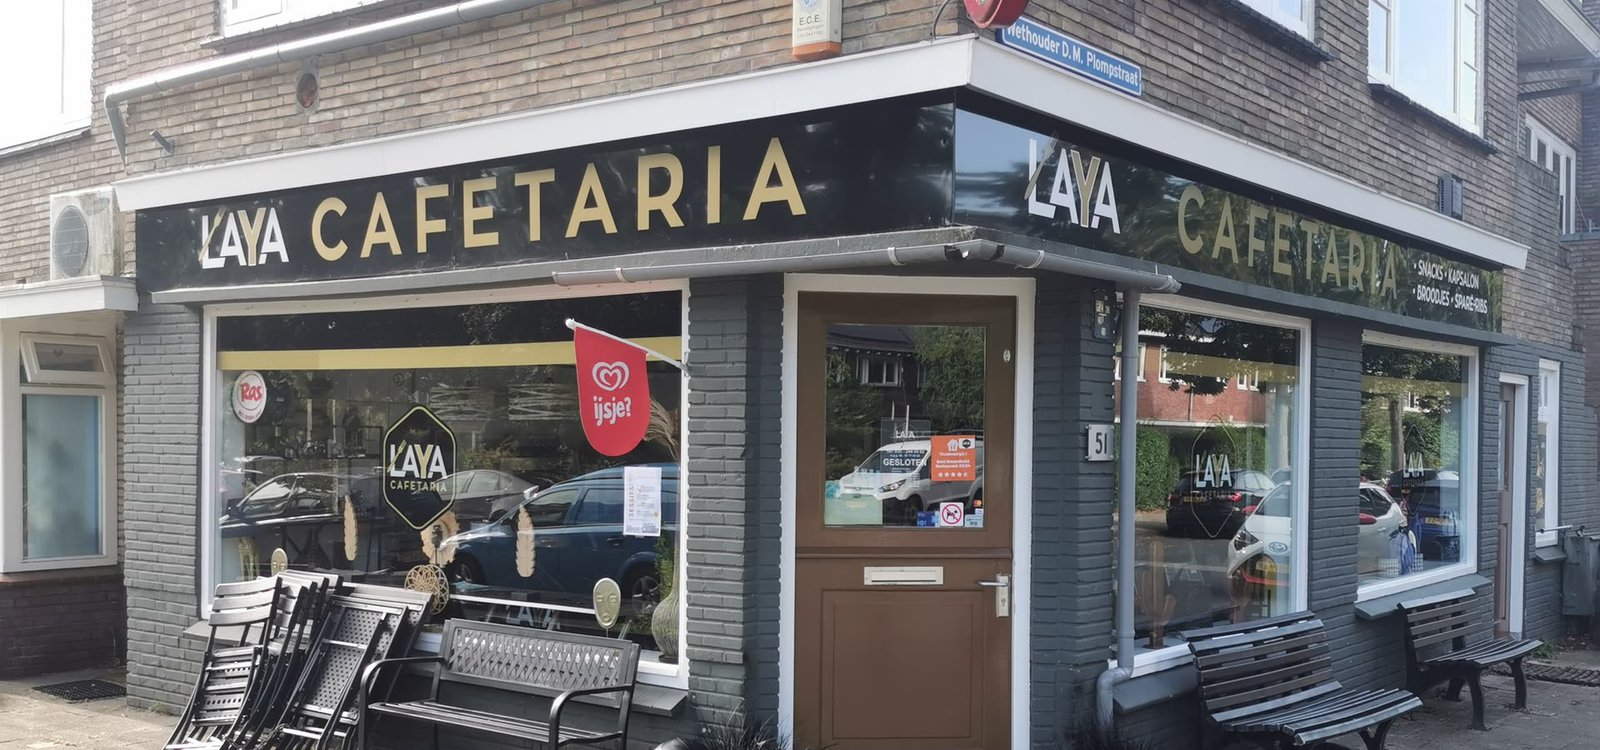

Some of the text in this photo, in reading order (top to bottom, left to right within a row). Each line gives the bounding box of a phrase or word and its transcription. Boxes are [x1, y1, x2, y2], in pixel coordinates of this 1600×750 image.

[1086, 51, 1139, 87] Plompstraat
[199, 136, 807, 269] LAYA CAFETARIA
[1027, 138, 1398, 300] LAYA CAFETARIA
[1418, 259, 1480, 290] SNACKS KAPSALON
[1416, 284, 1451, 307] BROODJES
[240, 382, 263, 402] Ras
[593, 395, 632, 427] ijsje?
[1095, 431, 1108, 455] 51
[388, 443, 448, 480] LAYA
[882, 457, 928, 467] GESLOTEN
[1195, 453, 1233, 488] LAYA
[389, 480, 448, 492] CAFETARIA
